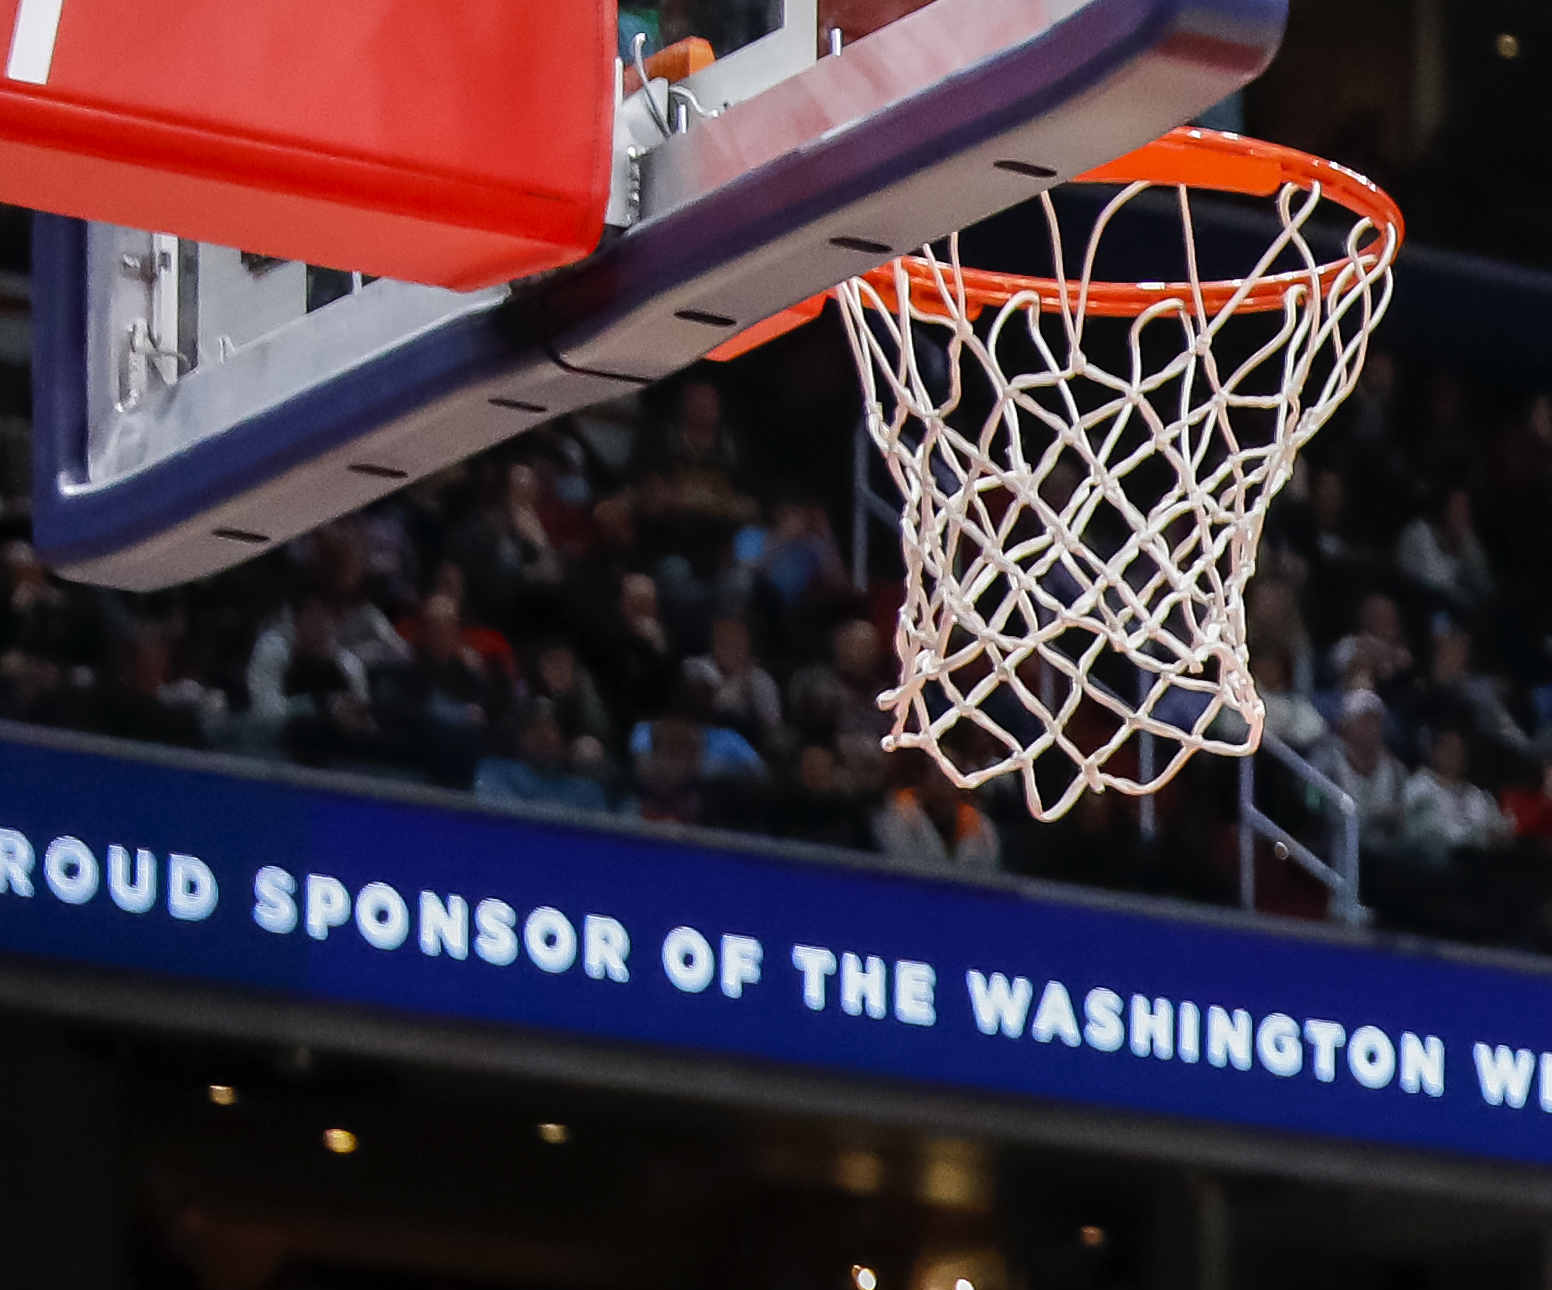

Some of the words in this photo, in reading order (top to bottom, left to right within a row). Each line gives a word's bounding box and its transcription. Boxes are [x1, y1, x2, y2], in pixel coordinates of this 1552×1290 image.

[252, 865, 630, 984] SPONSOR
[661, 926, 763, 999] OF
[793, 944, 937, 1027] THE
[967, 969, 1445, 1097] WASHINGTON
